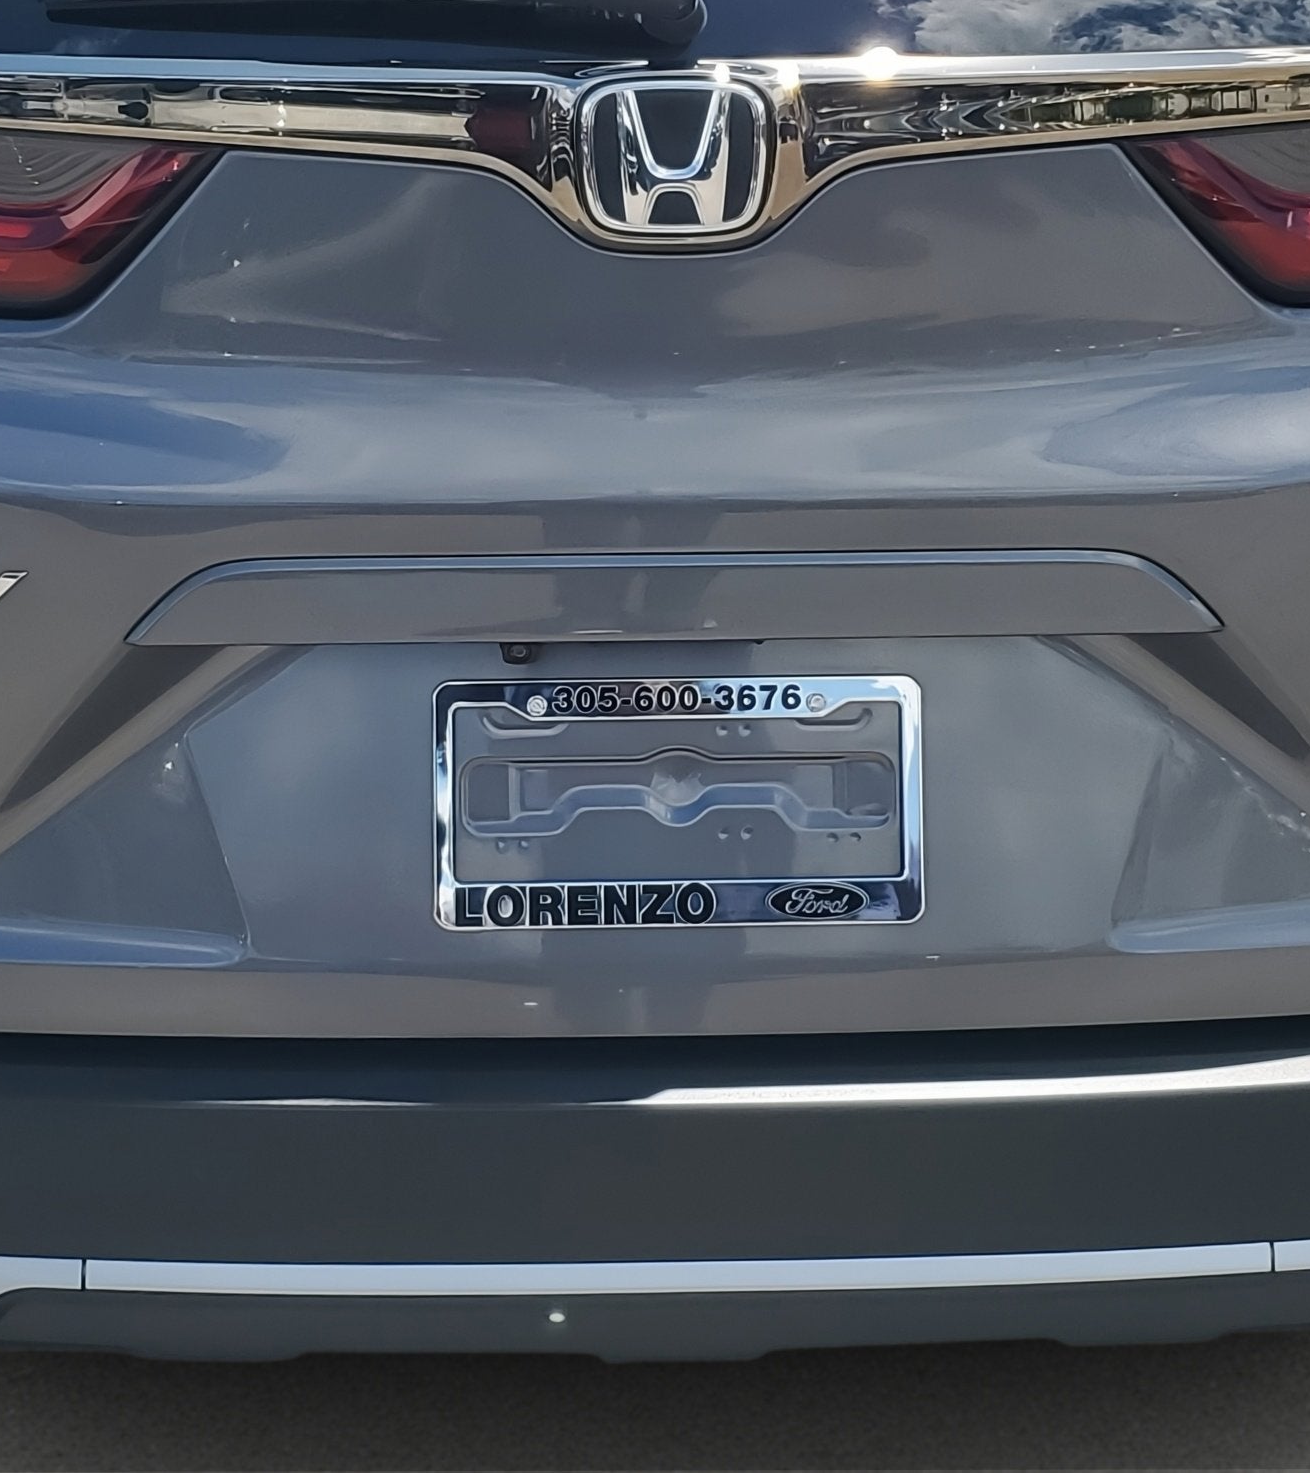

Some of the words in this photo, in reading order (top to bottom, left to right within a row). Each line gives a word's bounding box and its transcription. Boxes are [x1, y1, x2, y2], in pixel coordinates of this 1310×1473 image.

[551, 683, 803, 715] 305-600-3676
[454, 881, 717, 926] LORENZO
[785, 887, 850, 914] Ford
